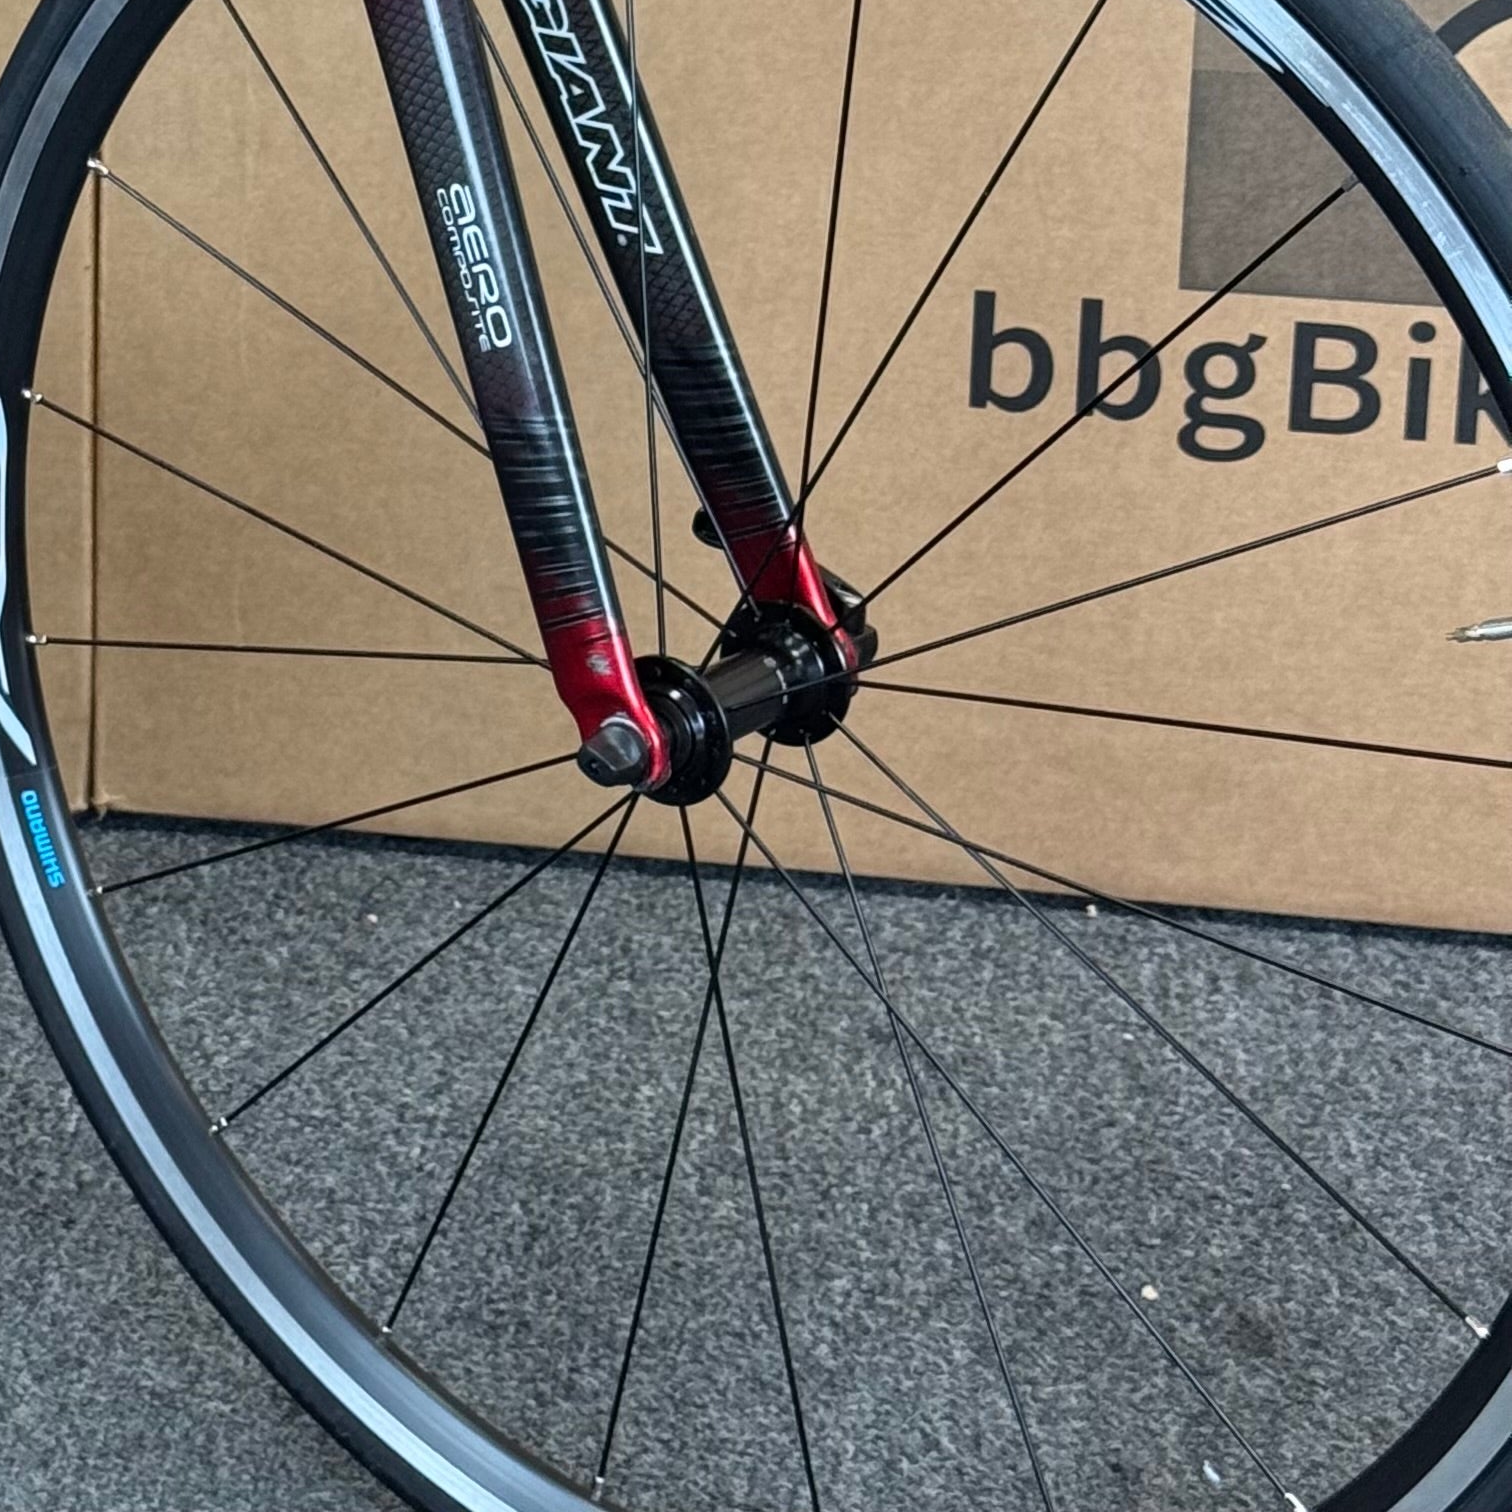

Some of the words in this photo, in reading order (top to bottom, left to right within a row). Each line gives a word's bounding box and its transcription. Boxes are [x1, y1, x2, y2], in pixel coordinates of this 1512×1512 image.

[436, 188, 491, 353] COMPOSITE
[449, 183, 512, 348] AERO
[20, 790, 66, 888] SHIMANO
